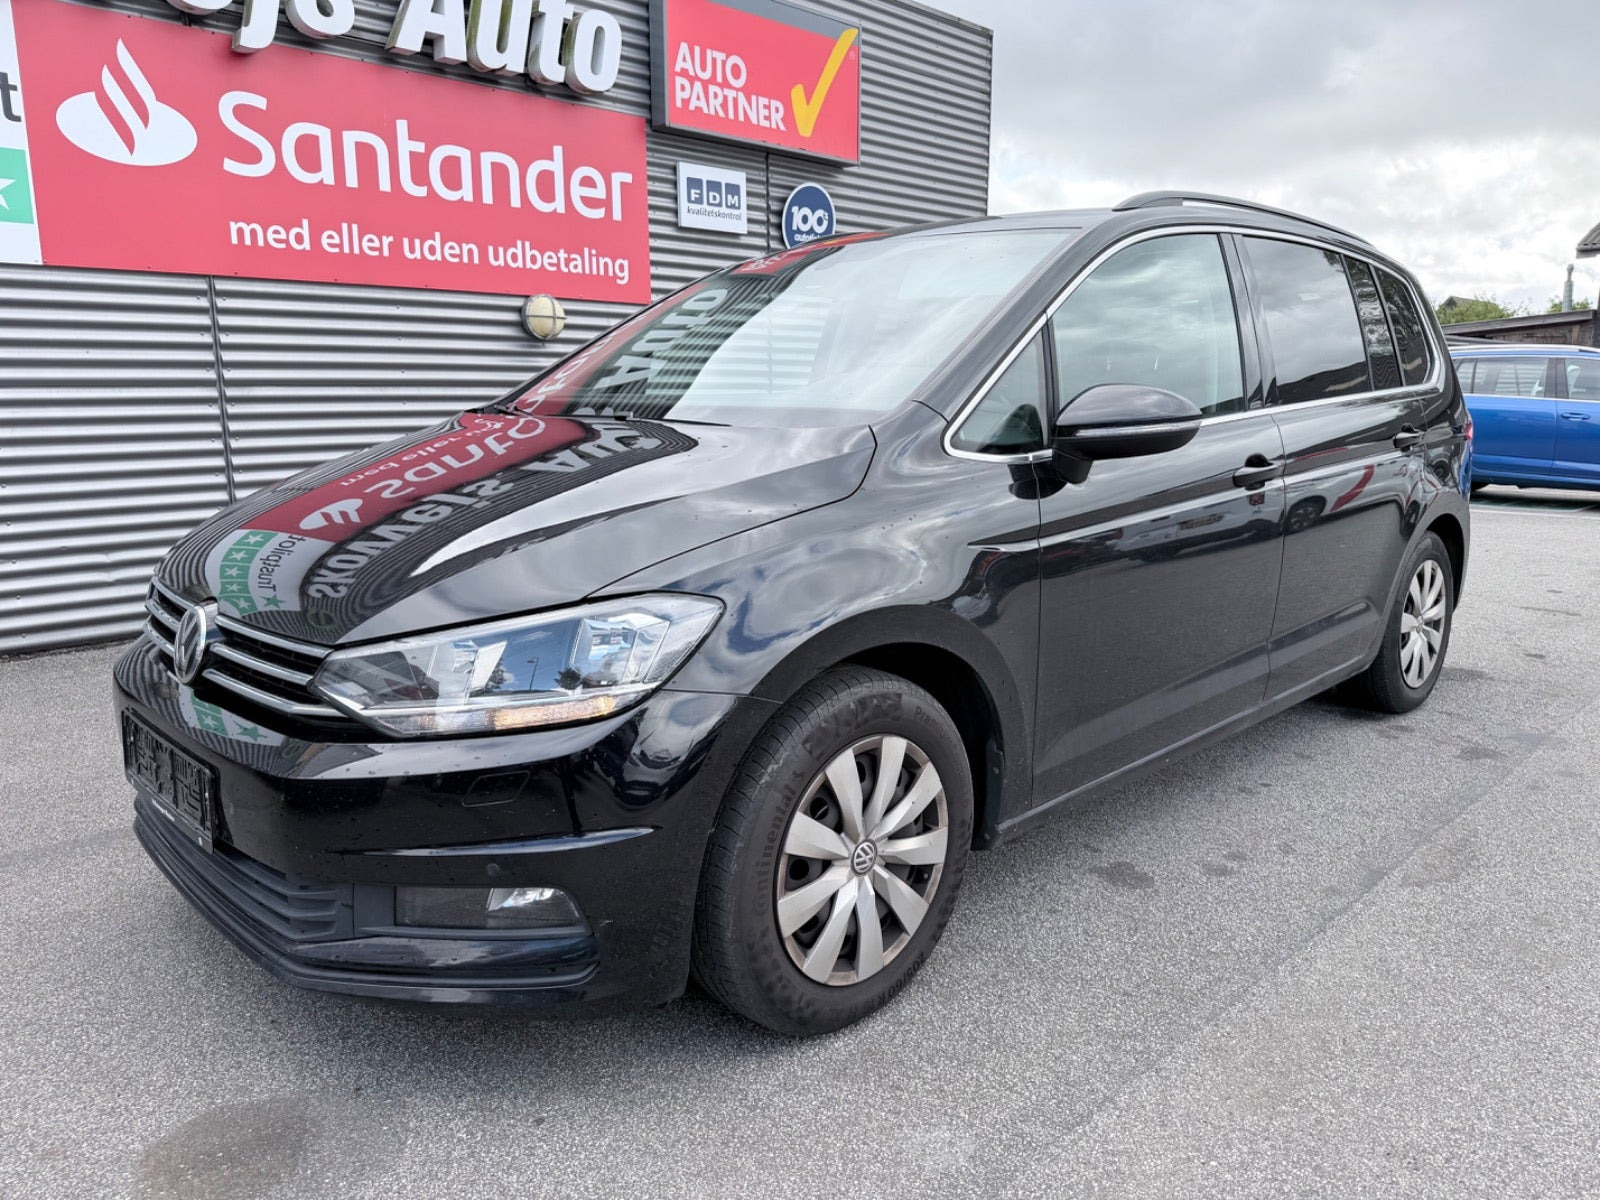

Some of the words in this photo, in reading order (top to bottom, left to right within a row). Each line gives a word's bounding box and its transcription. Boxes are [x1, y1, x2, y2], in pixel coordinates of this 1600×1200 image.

[674, 41, 747, 88] AUTO
[674, 76, 787, 131] PARTNER
[217, 90, 634, 222] Santander
[687, 205, 743, 221] kvalitetskontrol
[689, 188, 740, 208] FDM
[228, 218, 311, 252] med
[320, 222, 394, 258] eller
[403, 233, 480, 266] uden
[487, 241, 631, 285] udbetaling
